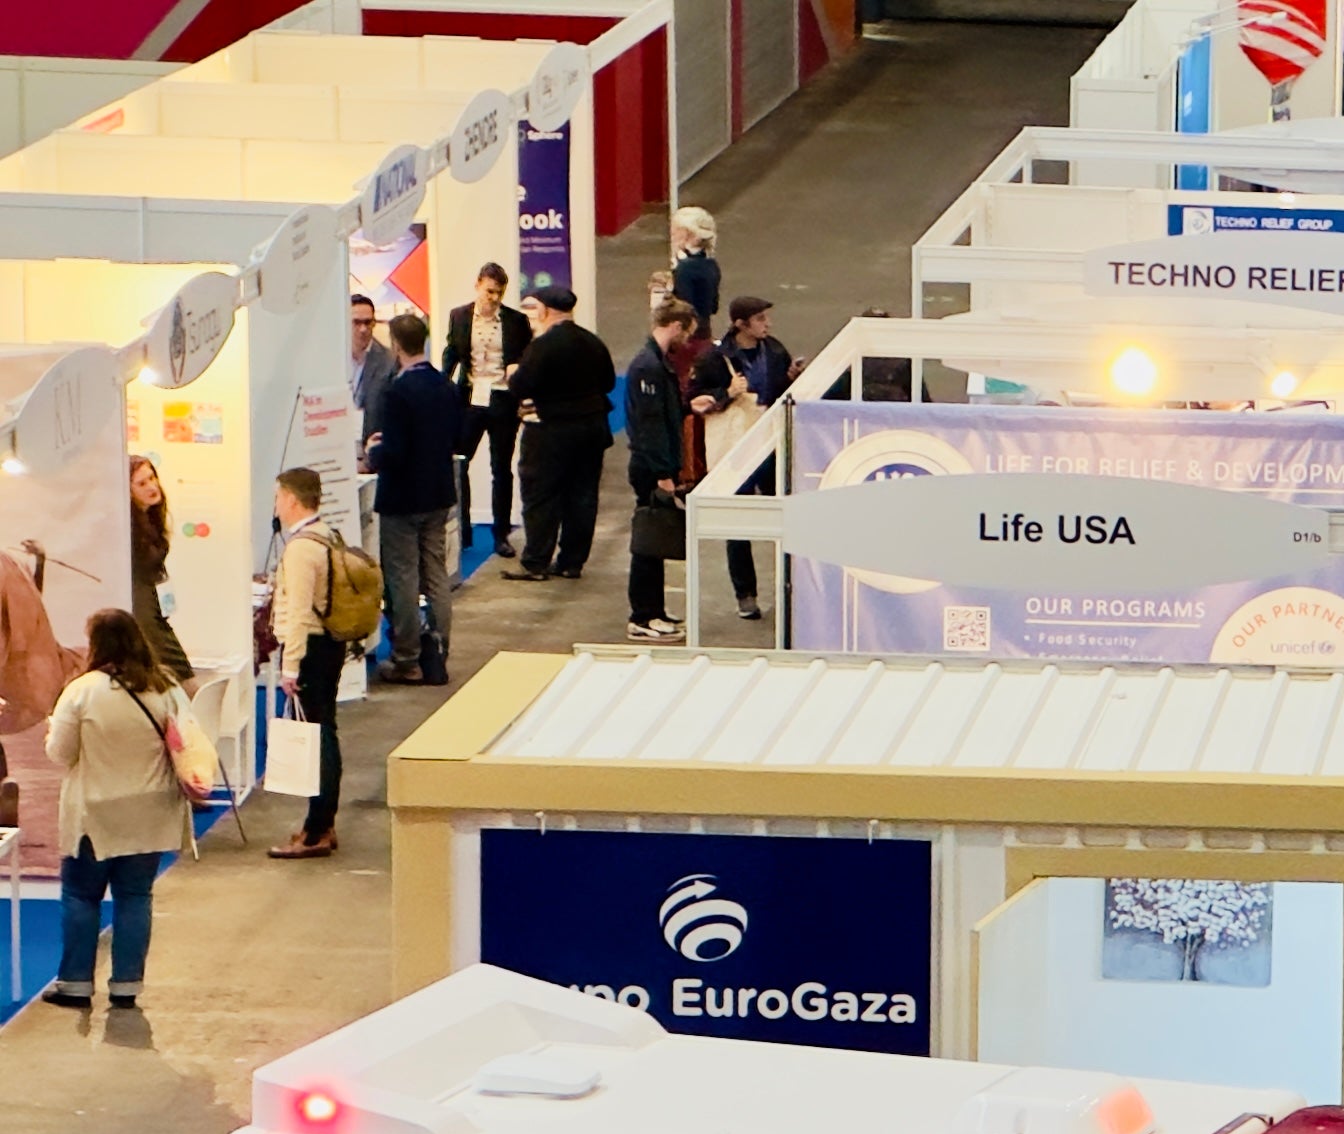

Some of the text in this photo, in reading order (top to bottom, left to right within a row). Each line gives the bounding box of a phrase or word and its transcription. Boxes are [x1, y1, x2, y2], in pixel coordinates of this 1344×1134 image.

[1215, 215, 1333, 231] TECHNO RELIEF GROUP
[1107, 261, 1237, 290] TECHNO
[1041, 456, 1089, 476] FOR
[1099, 457, 1177, 481] RELIEF
[1186, 460, 1204, 482] &
[978, 512, 1136, 546] Life USA
[1293, 531, 1322, 543] D1/b
[1025, 597, 1206, 619] OUR PROGRAMS
[1038, 632, 1137, 648] Food Security
[1231, 614, 1267, 649] OUR
[1270, 640, 1315, 655] unicef
[672, 978, 917, 1025] EuroGaza
